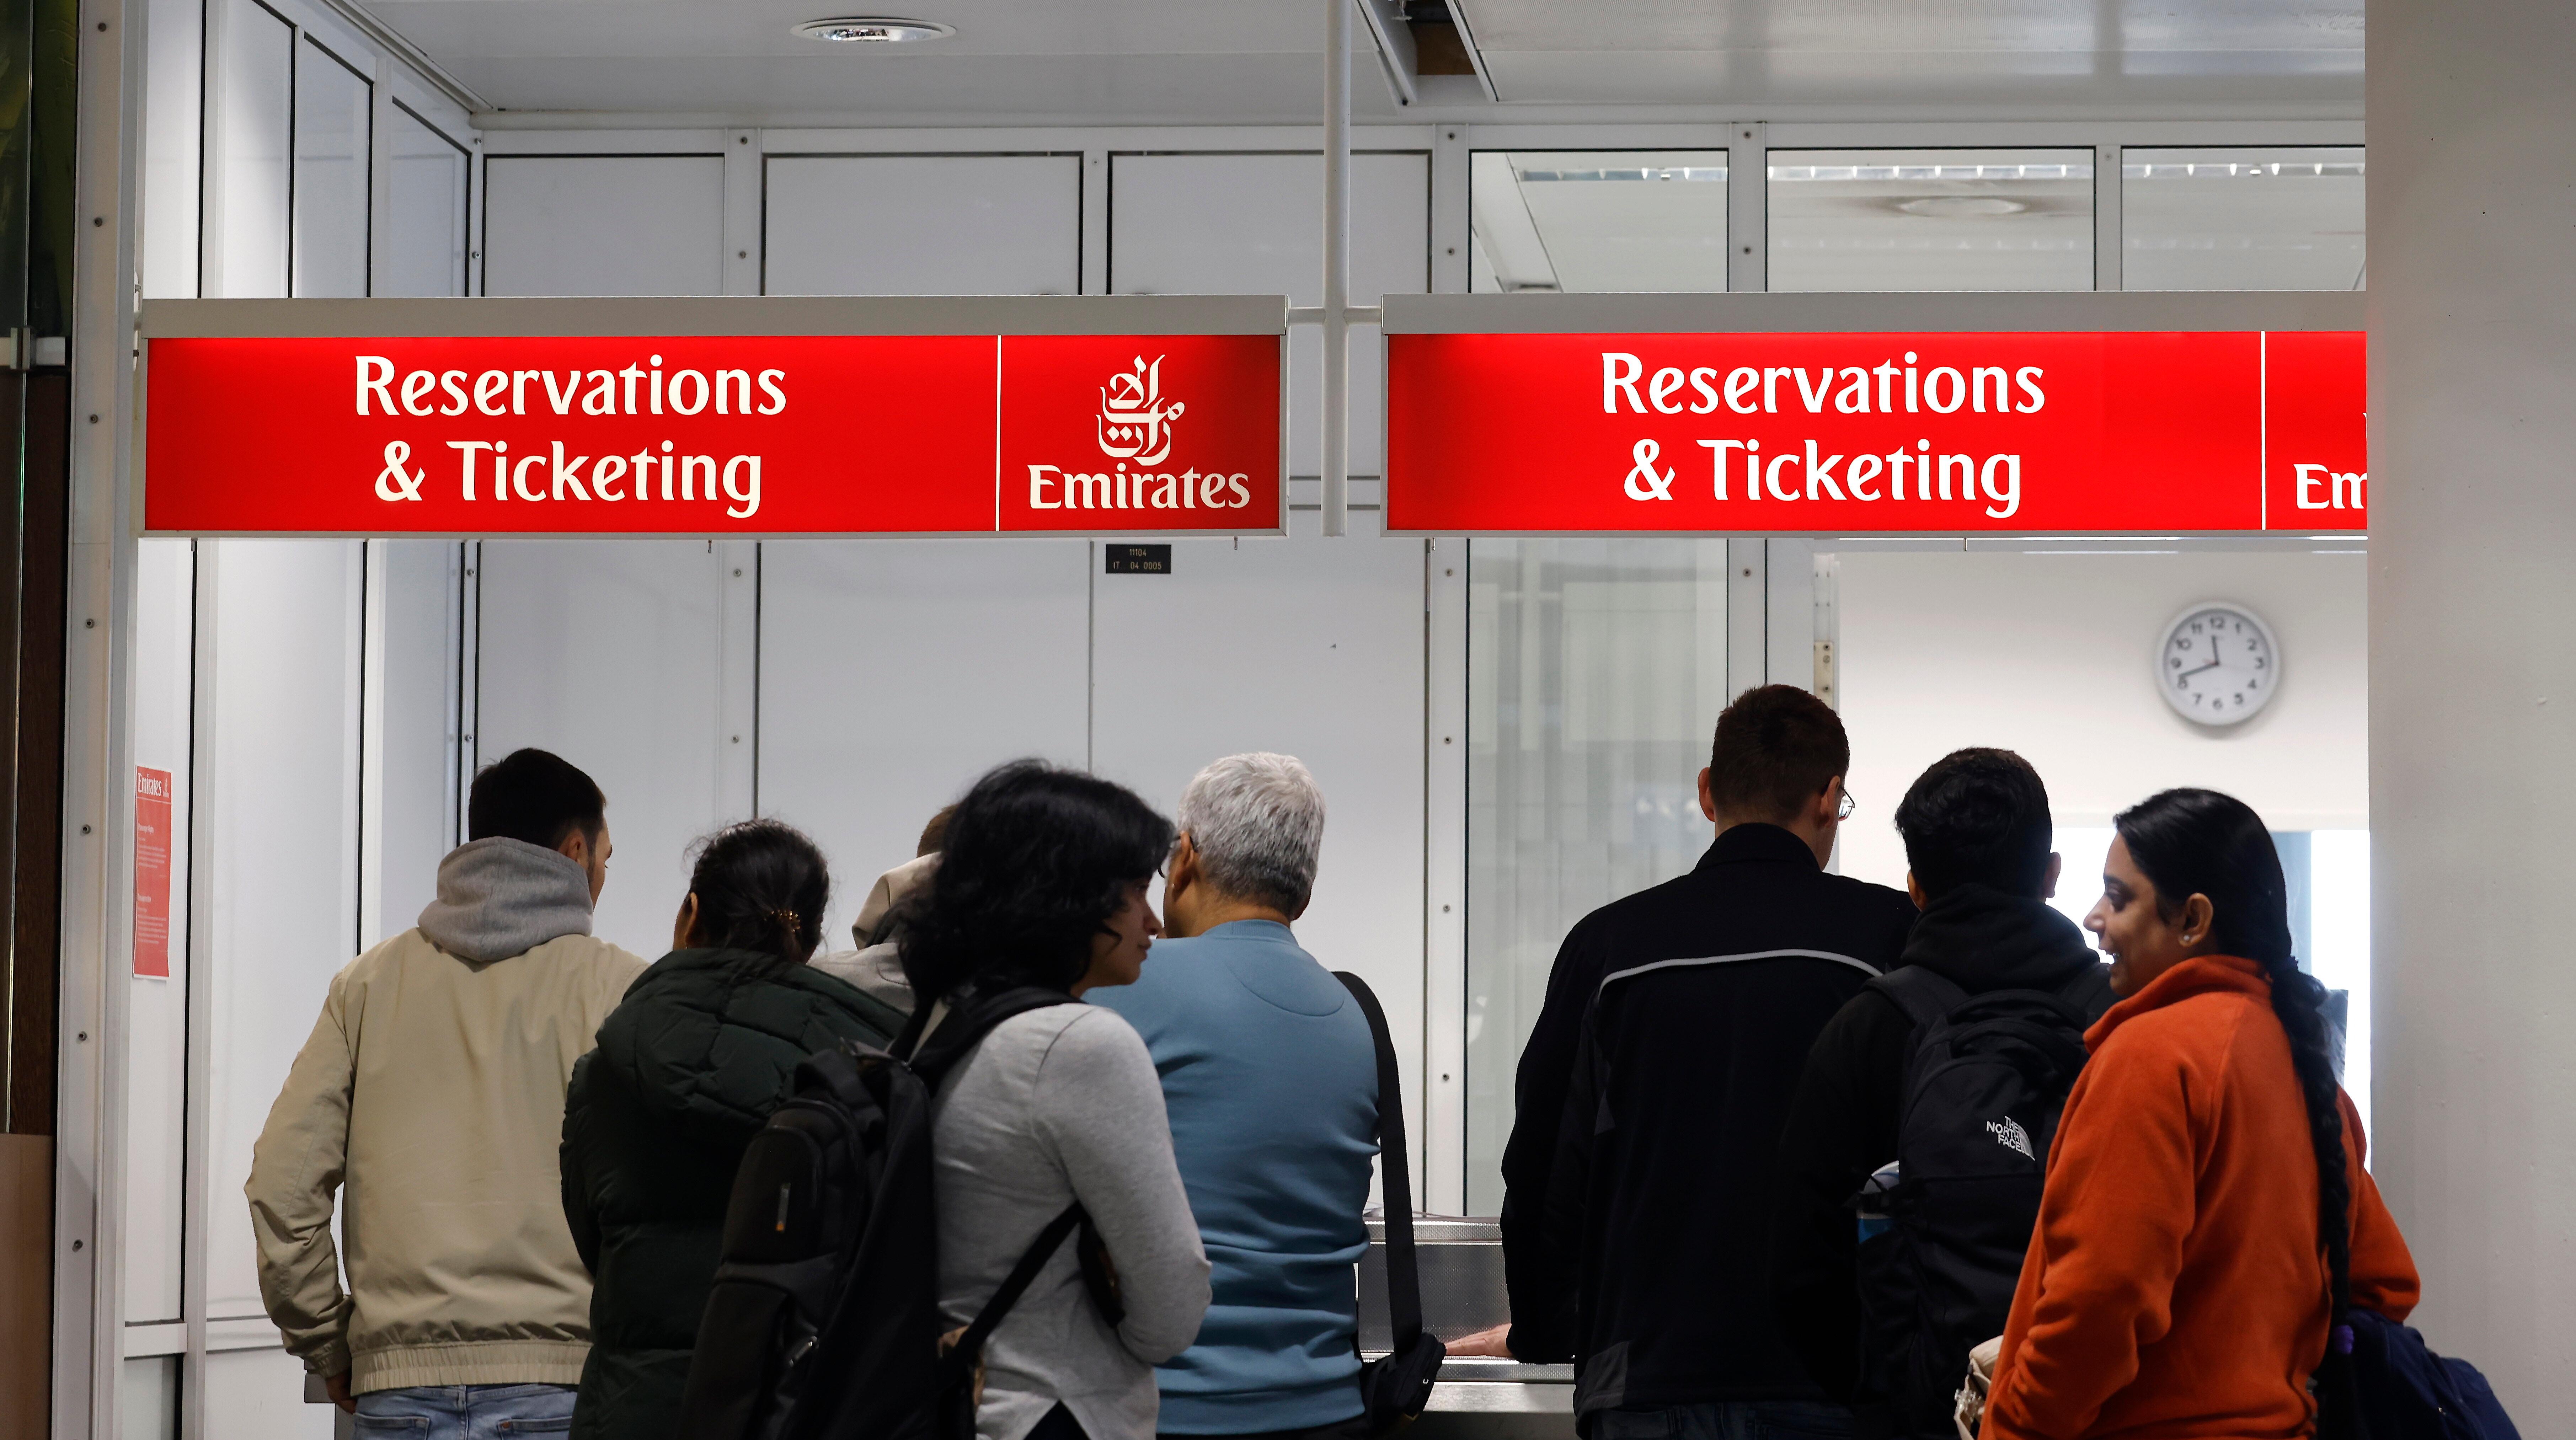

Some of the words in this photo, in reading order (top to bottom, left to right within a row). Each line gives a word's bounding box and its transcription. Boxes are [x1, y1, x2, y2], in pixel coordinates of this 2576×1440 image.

[356, 354, 786, 416] Reservations
[1602, 352, 2045, 414] Reservations
[375, 441, 425, 501] &
[446, 440, 760, 518] Ticketing
[1027, 463, 1250, 508] Emirates
[1624, 439, 1675, 500] &
[1696, 439, 2020, 518] Ticketing
[2247, 638, 2256, 651] 2
[2255, 657, 2265, 669] 3
[2192, 693, 2202, 705] 7
[138, 772, 162, 797] Emirates
[1986, 1120, 2020, 1142] NORTH
[2005, 1116, 2020, 1133] THE
[1998, 1133, 2022, 1152] FACE
